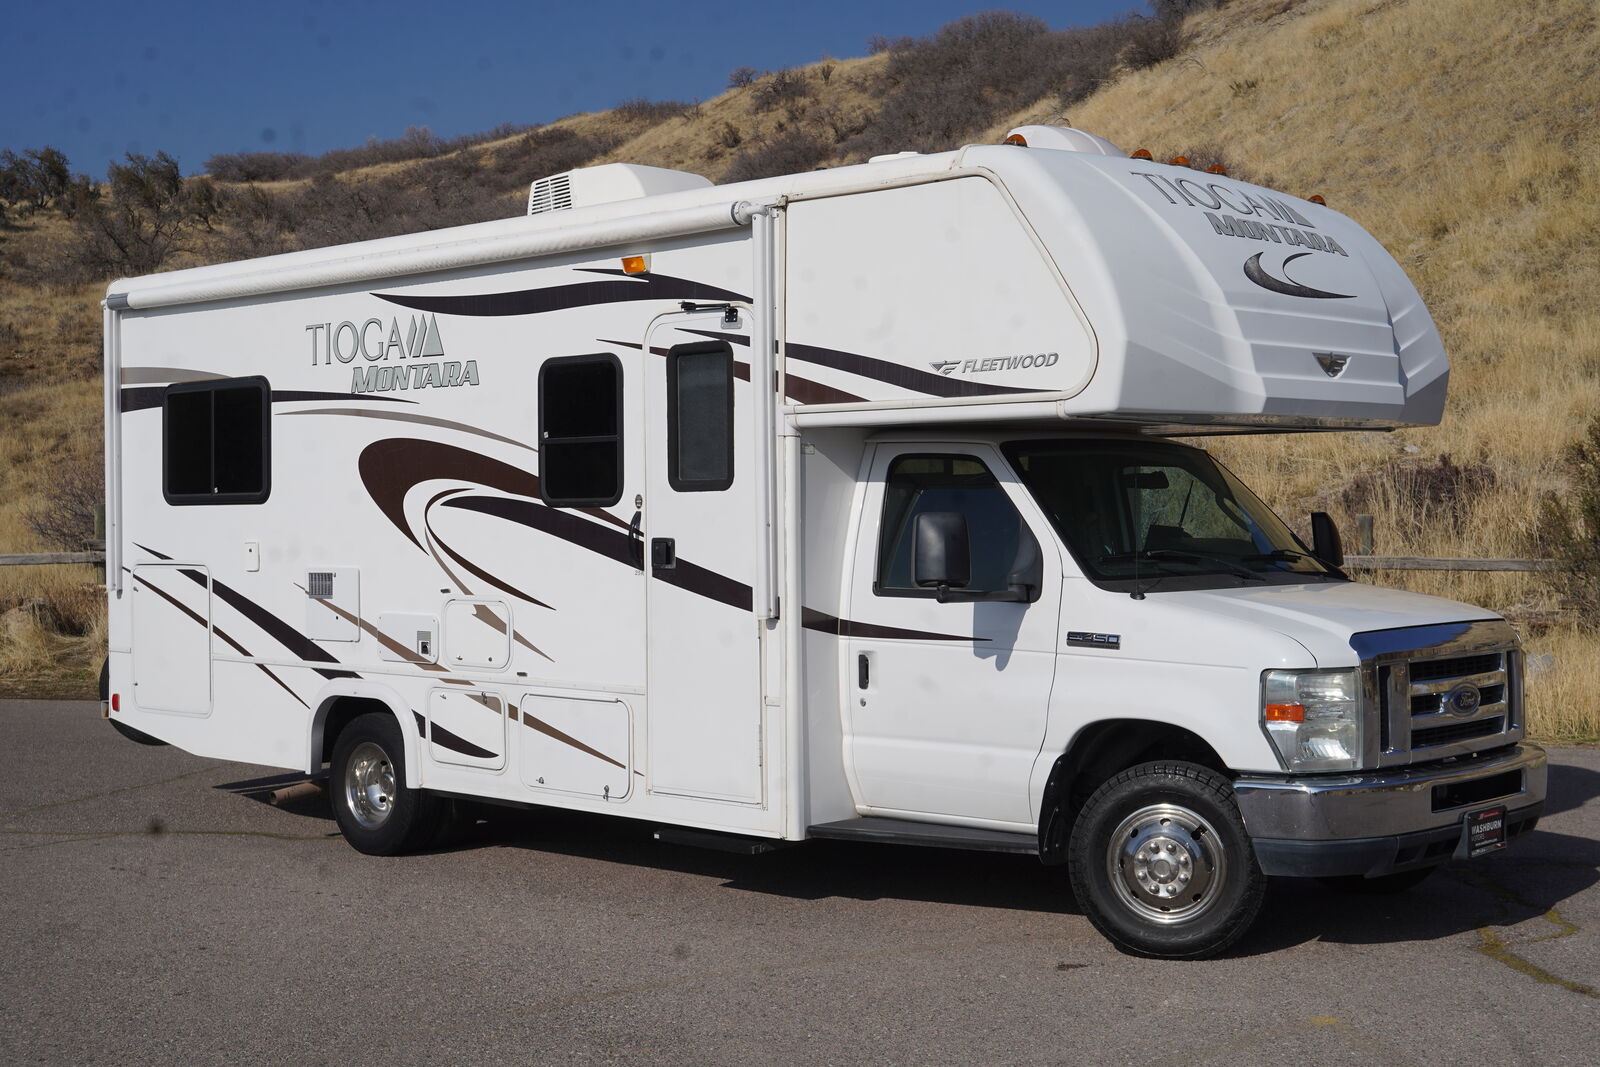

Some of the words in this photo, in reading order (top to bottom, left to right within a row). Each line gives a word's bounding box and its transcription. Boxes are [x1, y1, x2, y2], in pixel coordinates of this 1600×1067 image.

[1129, 171, 1280, 221] TIOGA
[1203, 211, 1349, 257] MONTARA
[305, 316, 407, 366] TIOGA
[350, 360, 480, 394] MONTARA
[961, 352, 1059, 374] FLEETWOOD
[1471, 819, 1502, 835] WASHBURN
